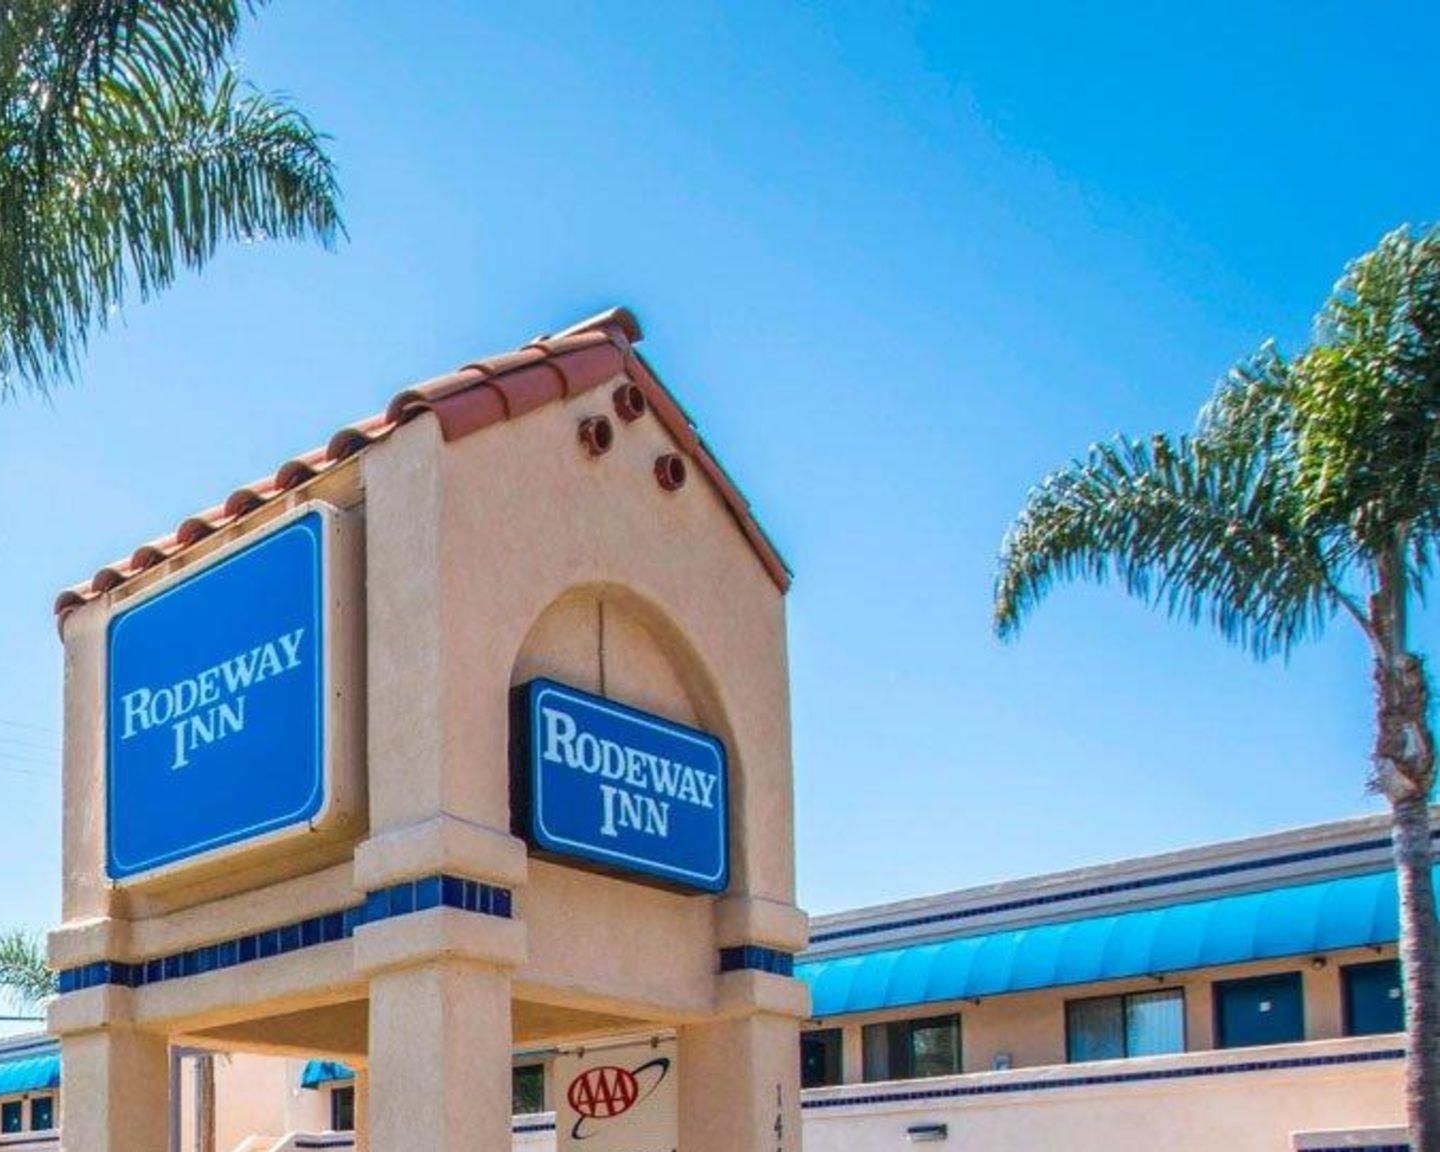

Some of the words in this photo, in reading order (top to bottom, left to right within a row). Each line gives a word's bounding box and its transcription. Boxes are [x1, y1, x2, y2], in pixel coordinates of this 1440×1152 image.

[120, 628, 304, 740] RODEWAY
[171, 696, 245, 770] INN
[542, 707, 717, 809] RODEWAY
[600, 785, 669, 838] INN
[573, 1066, 632, 1118] AAA
